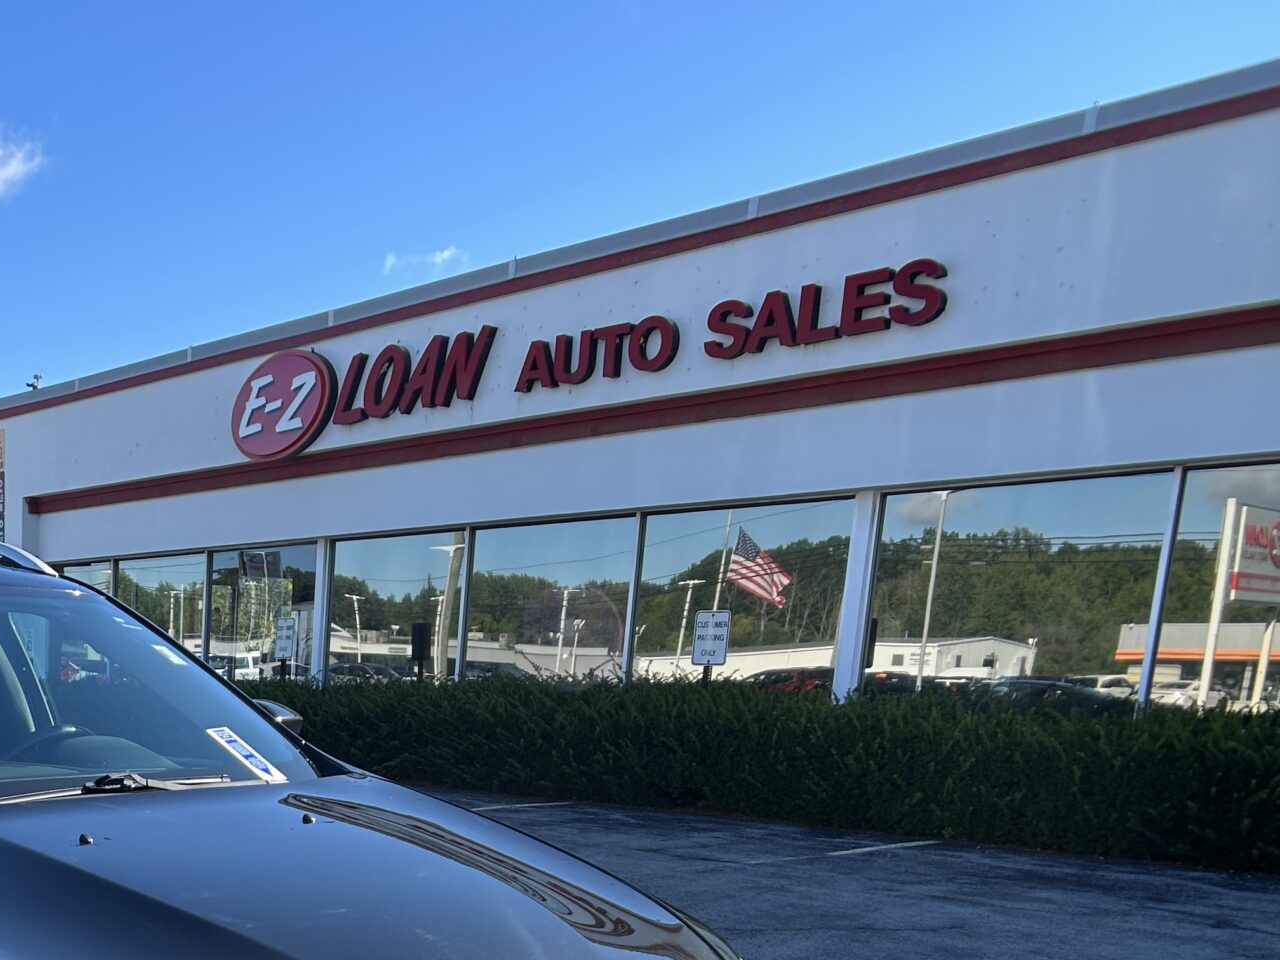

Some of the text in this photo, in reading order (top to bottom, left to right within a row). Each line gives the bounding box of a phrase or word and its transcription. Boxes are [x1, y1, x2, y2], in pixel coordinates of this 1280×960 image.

[237, 257, 948, 439] E-Z LOAN AUTO SALES
